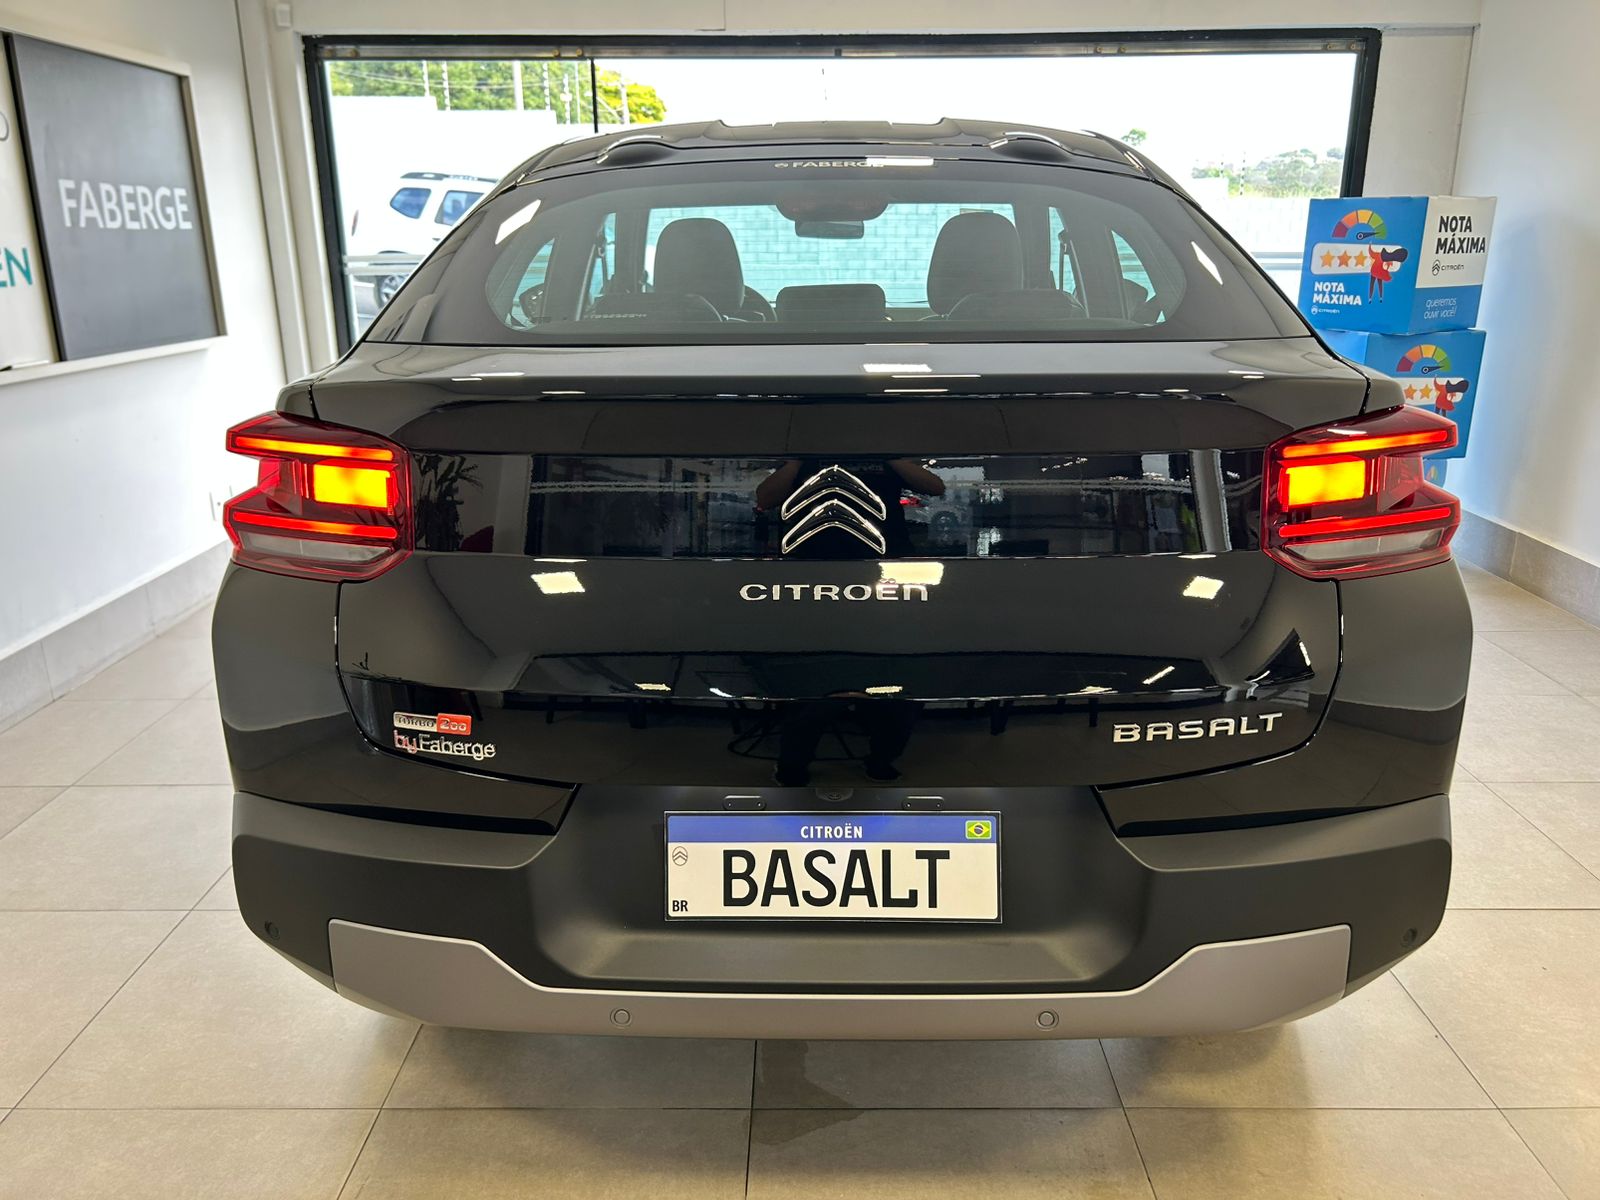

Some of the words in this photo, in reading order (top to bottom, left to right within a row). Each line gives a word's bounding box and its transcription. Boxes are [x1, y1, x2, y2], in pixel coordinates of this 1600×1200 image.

[58, 179, 193, 230] FABERGE
[1438, 215, 1472, 233] NOTA
[1435, 233, 1486, 254] MÁXIMA
[1314, 281, 1345, 293] NOTA
[1312, 292, 1362, 305] MÁXIMA
[1425, 297, 1457, 310] queremos
[1423, 309, 1440, 320] ouvir
[396, 715, 435, 728] TURBO
[439, 718, 467, 732] 200
[1112, 712, 1283, 744] BASALT
[418, 733, 497, 761] Faberge
[800, 823, 863, 839] CITROËN
[722, 848, 951, 909] BASALT
[672, 900, 689, 912] BR
